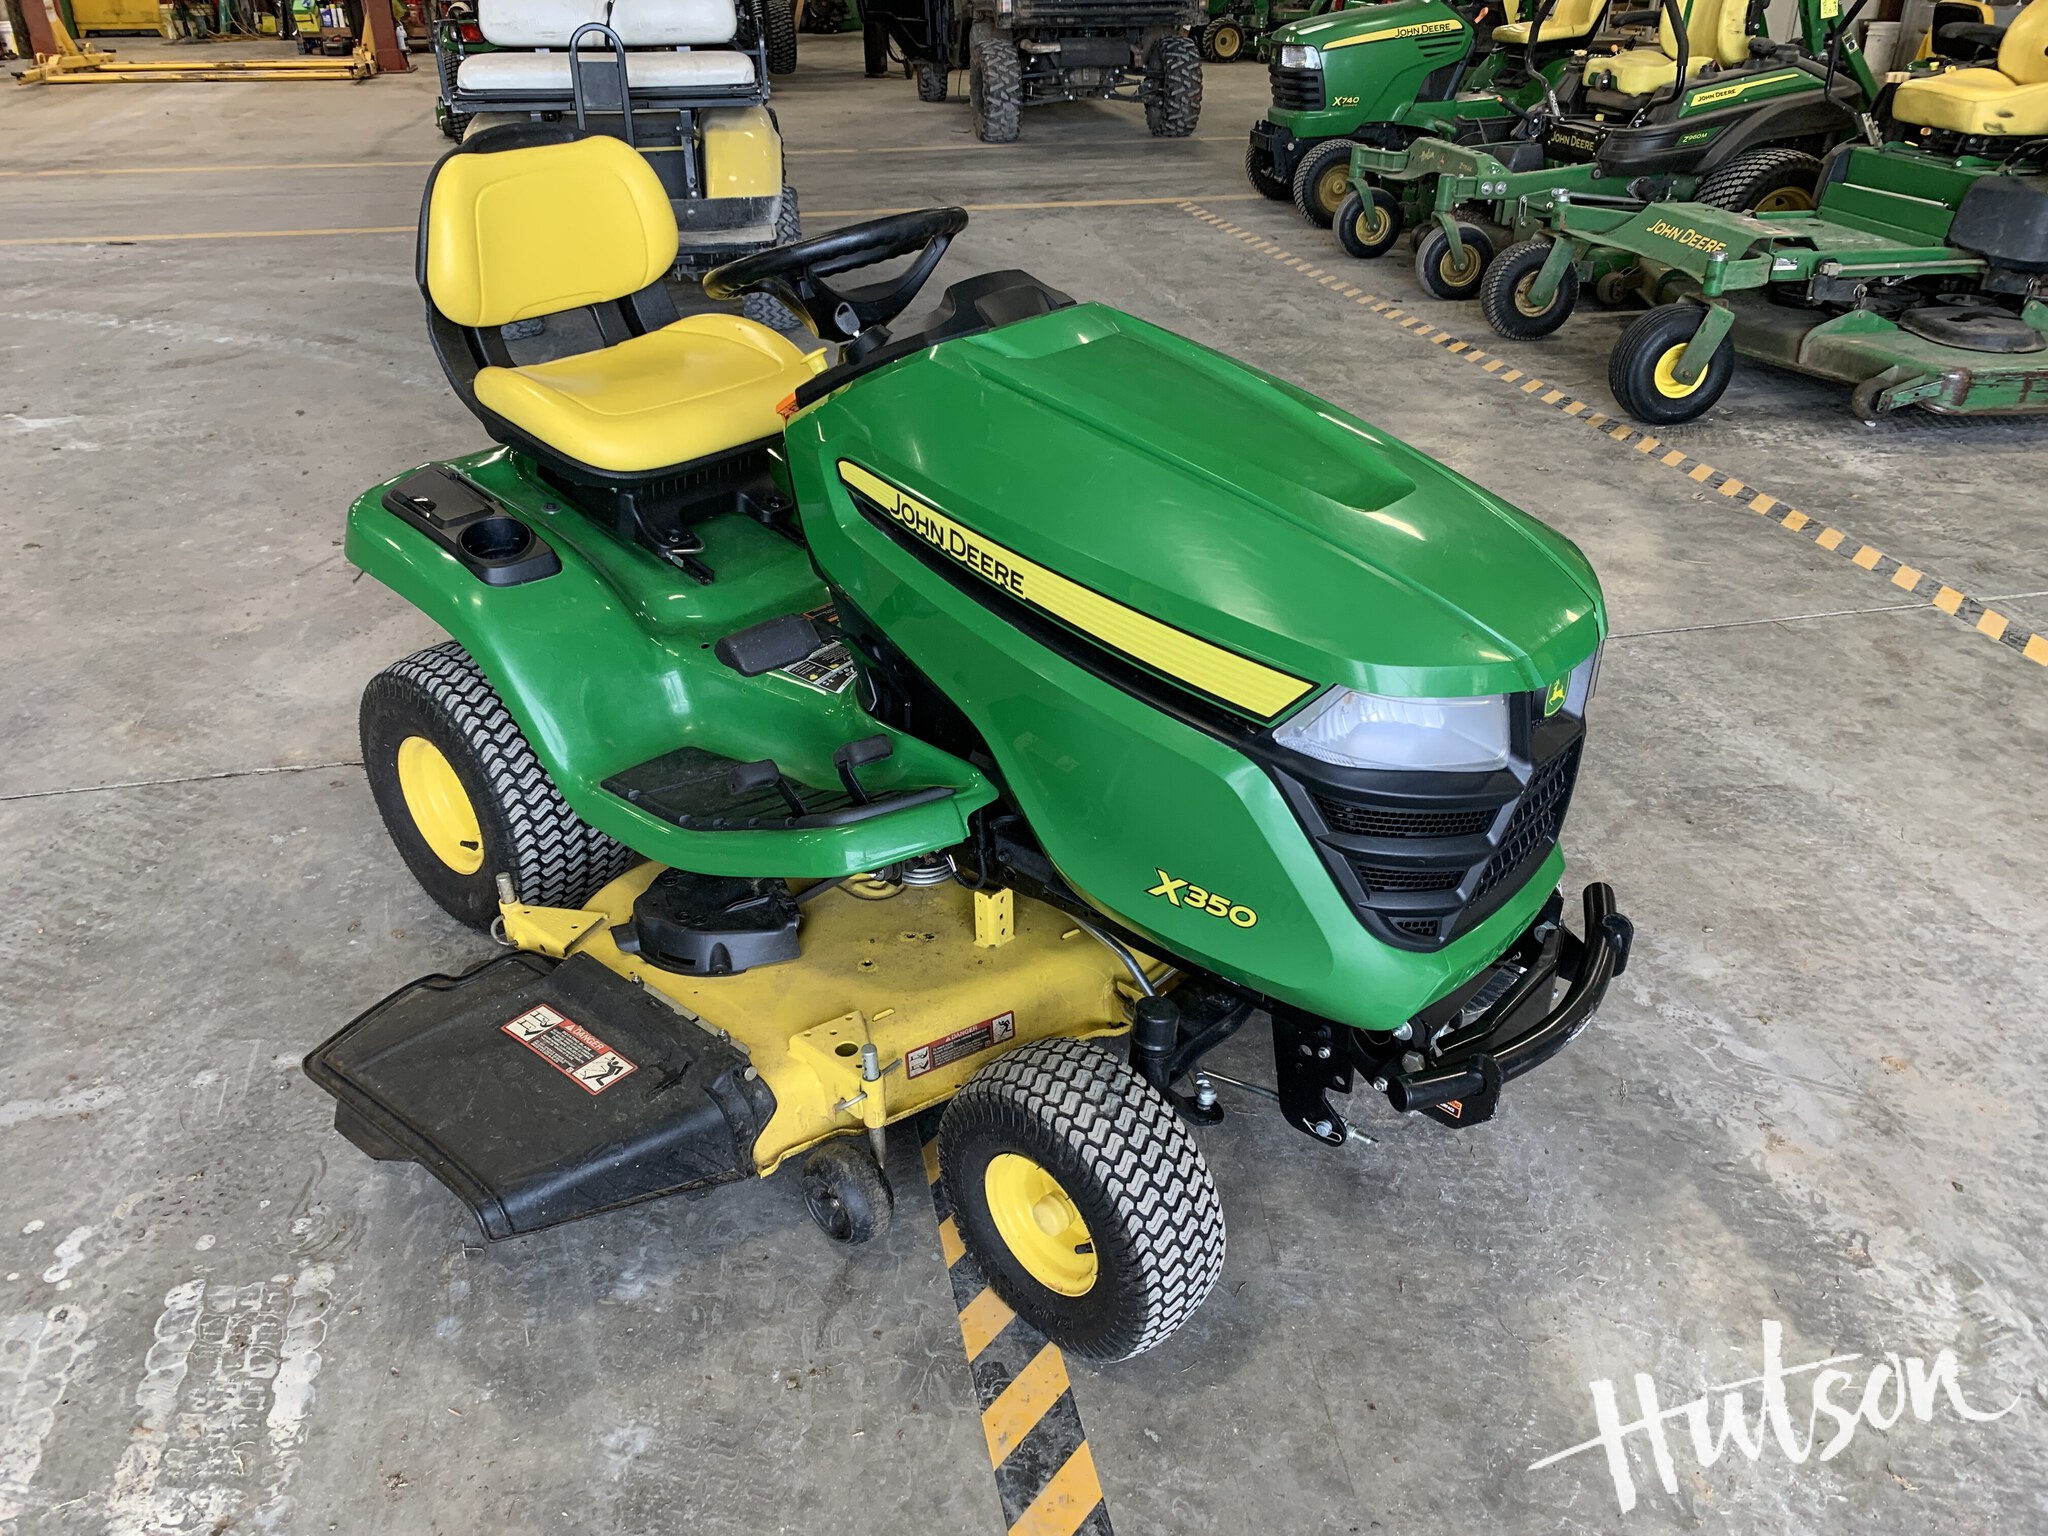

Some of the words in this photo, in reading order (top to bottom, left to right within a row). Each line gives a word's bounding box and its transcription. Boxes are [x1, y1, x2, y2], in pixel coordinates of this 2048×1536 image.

[1395, 26, 1420, 37] JOHN
[1421, 23, 1451, 33] DEERE
[1332, 96, 1360, 107] X740
[1697, 94, 1715, 102] JOHN
[1715, 88, 1736, 98] DEERE
[1551, 131, 1570, 146] JOHN
[1570, 135, 1595, 152] DEERE
[1646, 218, 1684, 241] JOHN
[1678, 228, 1727, 253] DEERE
[890, 493, 944, 546] JOHN
[949, 527, 1025, 596] DEERE
[1144, 867, 1258, 928] X350
[572, 1027, 605, 1051] DANGER
[951, 1025, 978, 1040] DANGER
